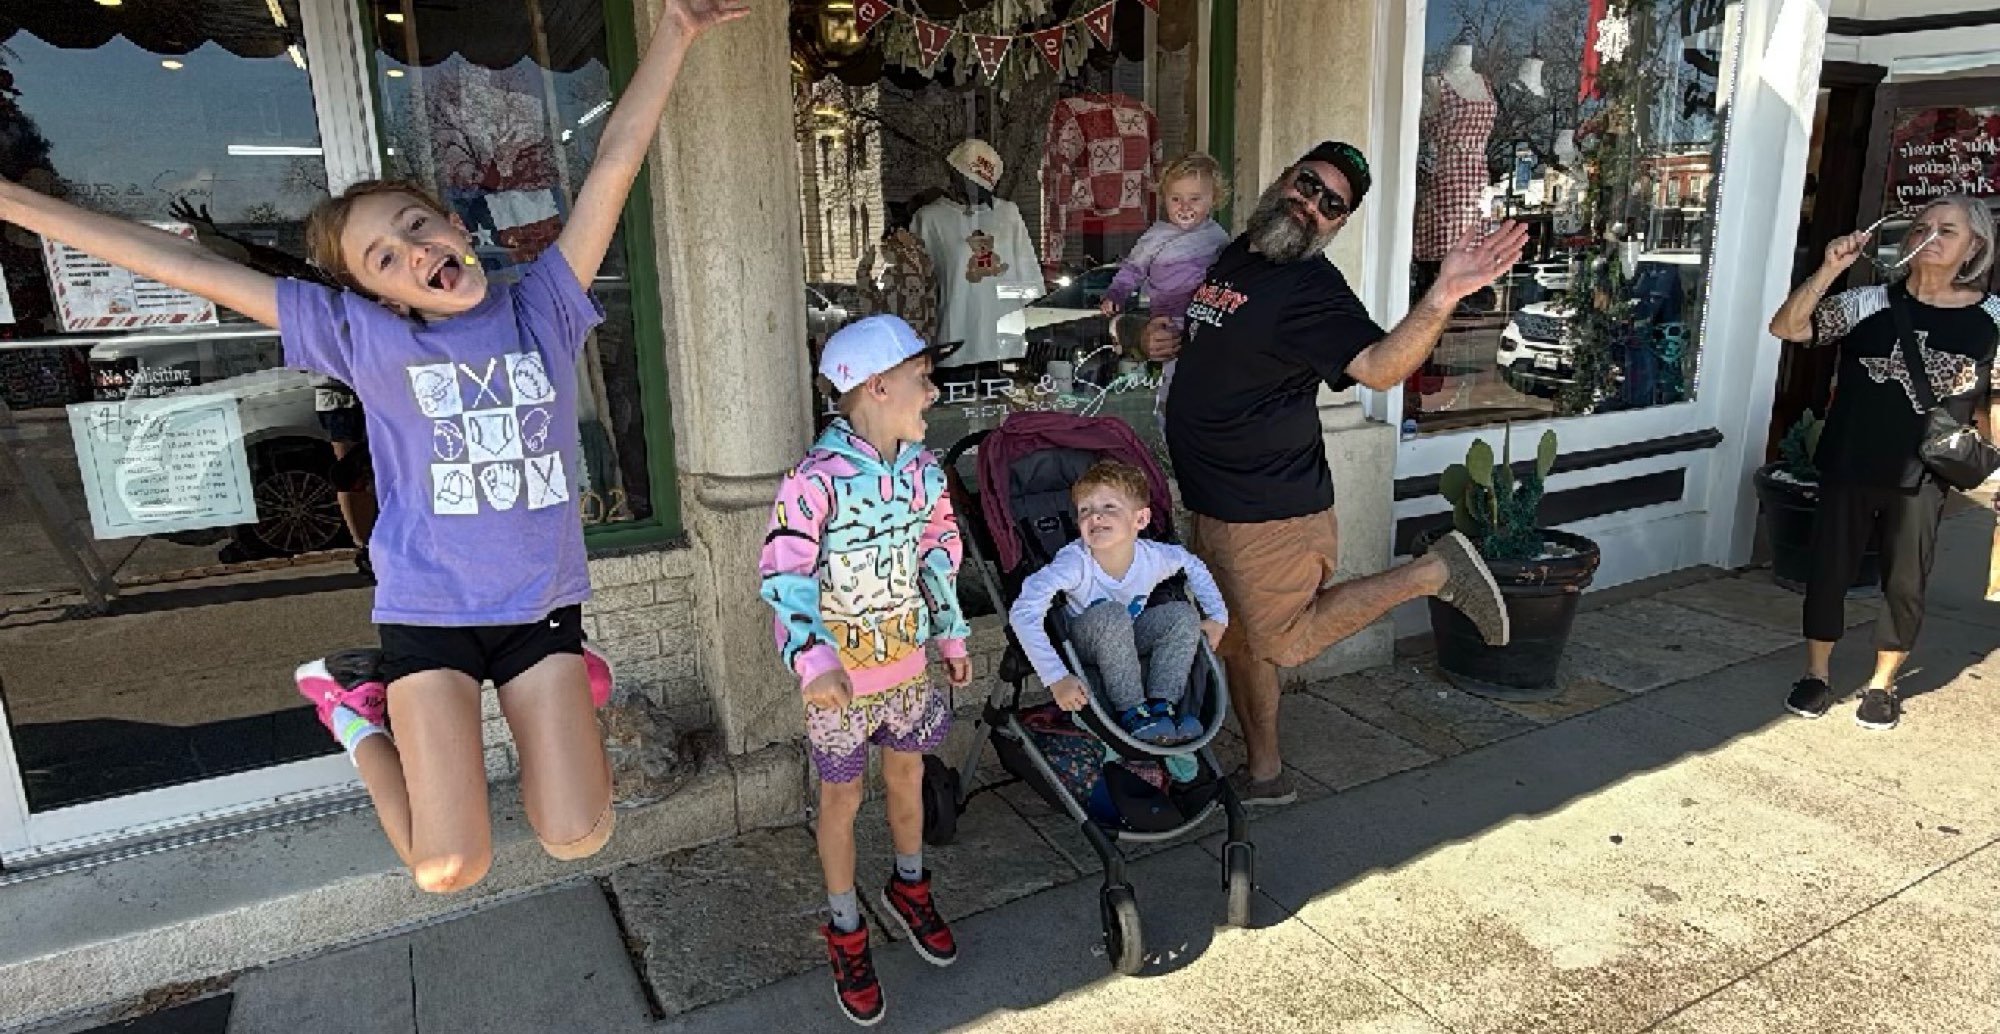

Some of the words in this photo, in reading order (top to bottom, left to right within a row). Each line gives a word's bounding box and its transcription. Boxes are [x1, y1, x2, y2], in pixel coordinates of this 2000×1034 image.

[99, 370, 123, 386] No
[124, 366, 193, 385] Soliciting
[1034, 374, 1058, 395] &
